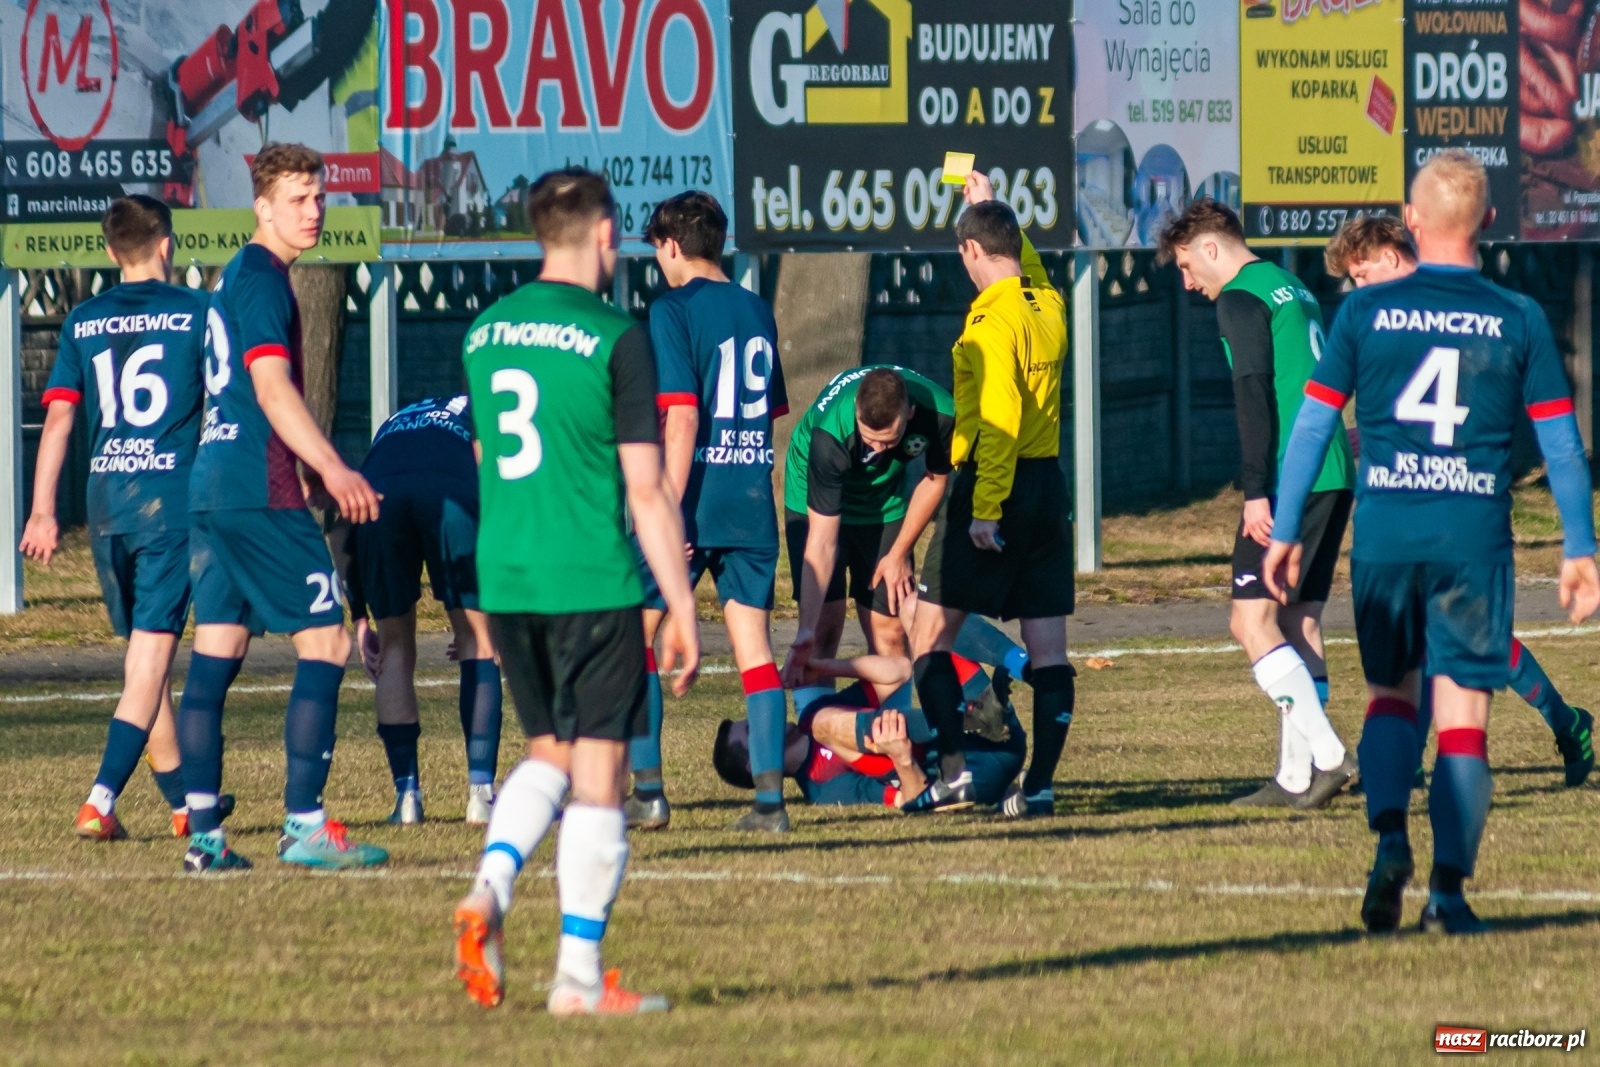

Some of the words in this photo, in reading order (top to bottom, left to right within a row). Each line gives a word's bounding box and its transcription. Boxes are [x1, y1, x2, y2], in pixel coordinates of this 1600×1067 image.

[1119, 0, 1161, 25] Sala
[1169, 0, 1196, 25] do
[919, 23, 1054, 62] BUDUJEMY
[1257, 50, 1331, 68] WYKONAM
[1336, 50, 1388, 68] USŁUGI
[384, 0, 716, 134] BRAVO
[1104, 39, 1211, 81] Wynajęcia
[1415, 38, 1508, 100] DRÓB
[919, 86, 958, 125] OD
[966, 87, 985, 125] A
[992, 86, 1031, 125] DO
[1038, 87, 1055, 124] Z
[1291, 80, 1359, 103] KOPARKĄ
[1127, 101, 1149, 122] tel.
[1152, 99, 1174, 122] 519
[1178, 99, 1203, 122] 847
[1207, 99, 1232, 122] 833
[1416, 107, 1508, 142] WĘDLINY
[1298, 136, 1348, 154] USŁUGI
[26, 151, 72, 178] 608
[80, 149, 122, 177] 465
[131, 149, 172, 176] 635
[640, 156, 673, 186] 744
[681, 155, 712, 185] 173
[1268, 166, 1378, 185] TRANSPORTOWE
[752, 164, 814, 232] tel.
[822, 168, 896, 232] 665
[1280, 209, 1311, 231] 880
[74, 313, 193, 339] HRYCKIEWICZ
[492, 321, 600, 357] TWORKÓW
[1373, 308, 1503, 338] ADAMCZYK
[92, 343, 168, 428] 16
[713, 336, 773, 419] 19
[1395, 346, 1470, 447] 4
[491, 368, 543, 480] 3
[1396, 452, 1419, 474] KS
[1423, 455, 1468, 478] 1905
